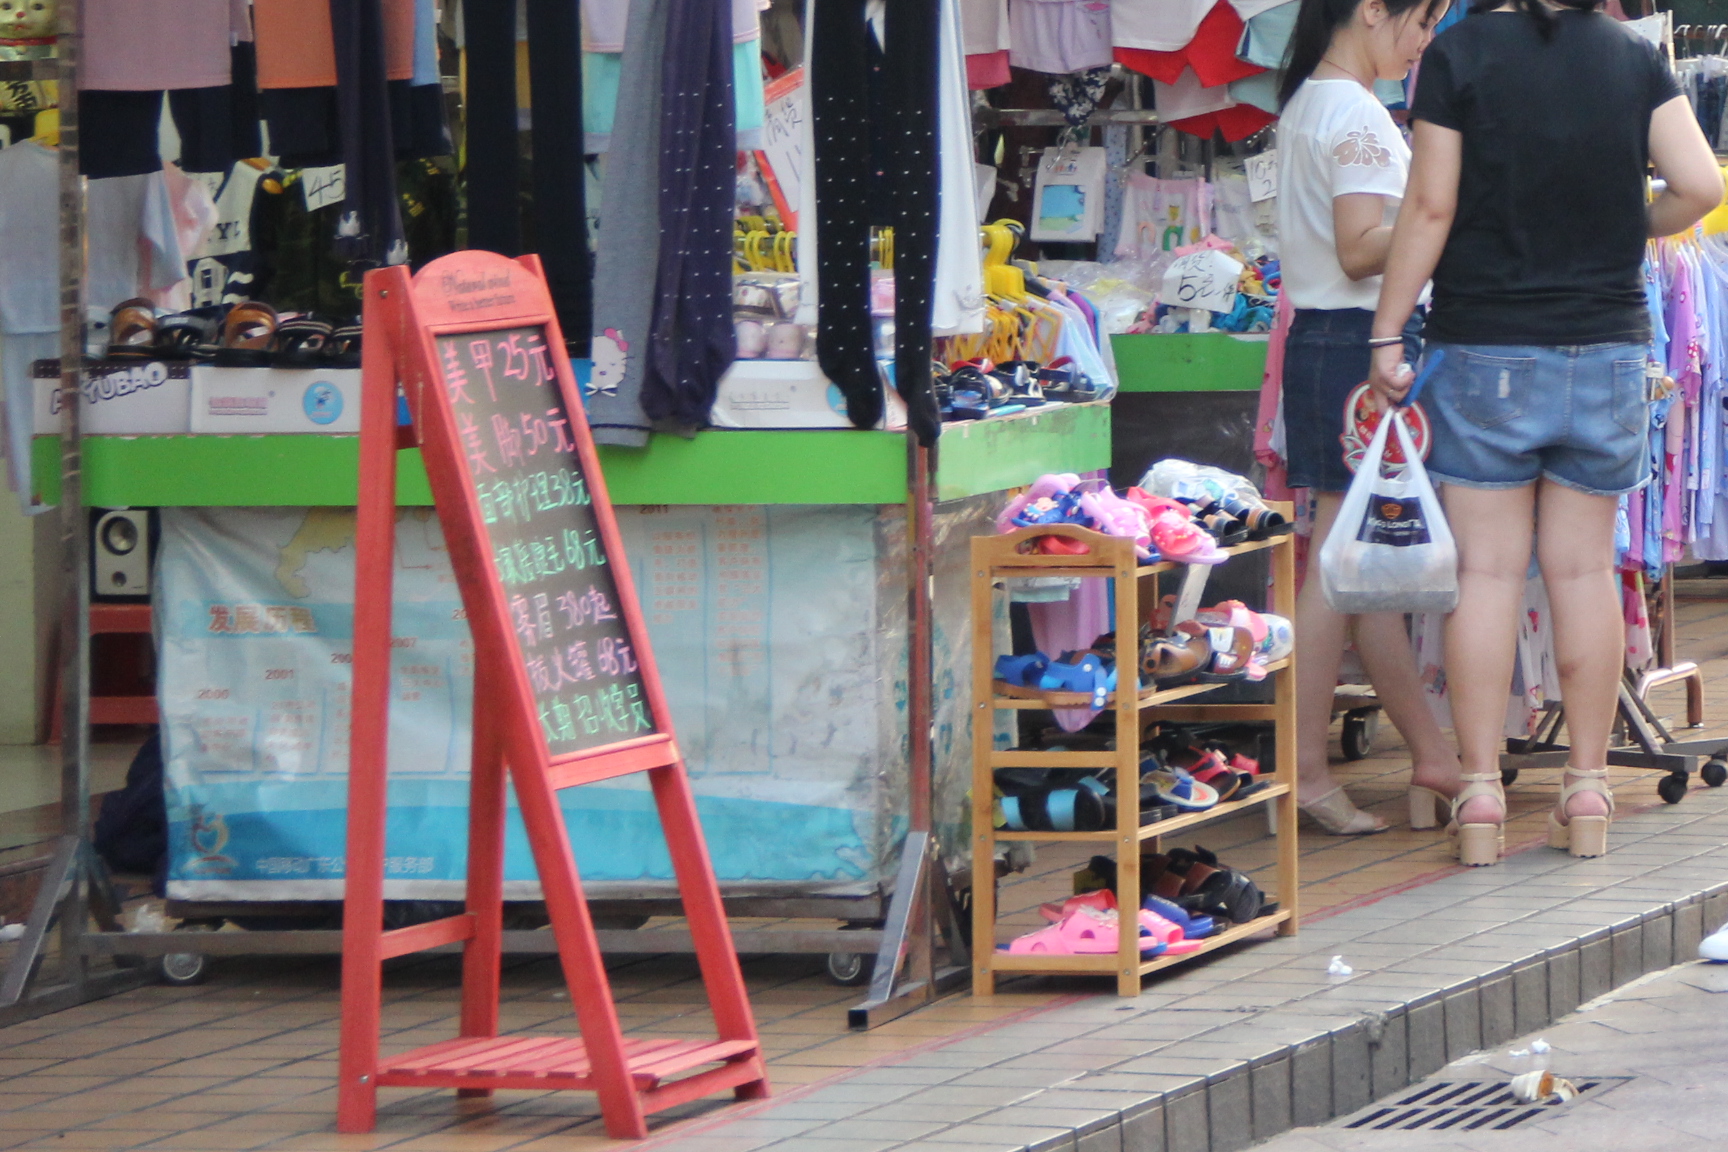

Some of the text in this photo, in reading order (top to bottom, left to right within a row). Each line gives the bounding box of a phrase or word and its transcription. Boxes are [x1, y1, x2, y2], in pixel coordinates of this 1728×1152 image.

[208, 604, 318, 635] 发展历程
[264, 668, 296, 681] 2001
